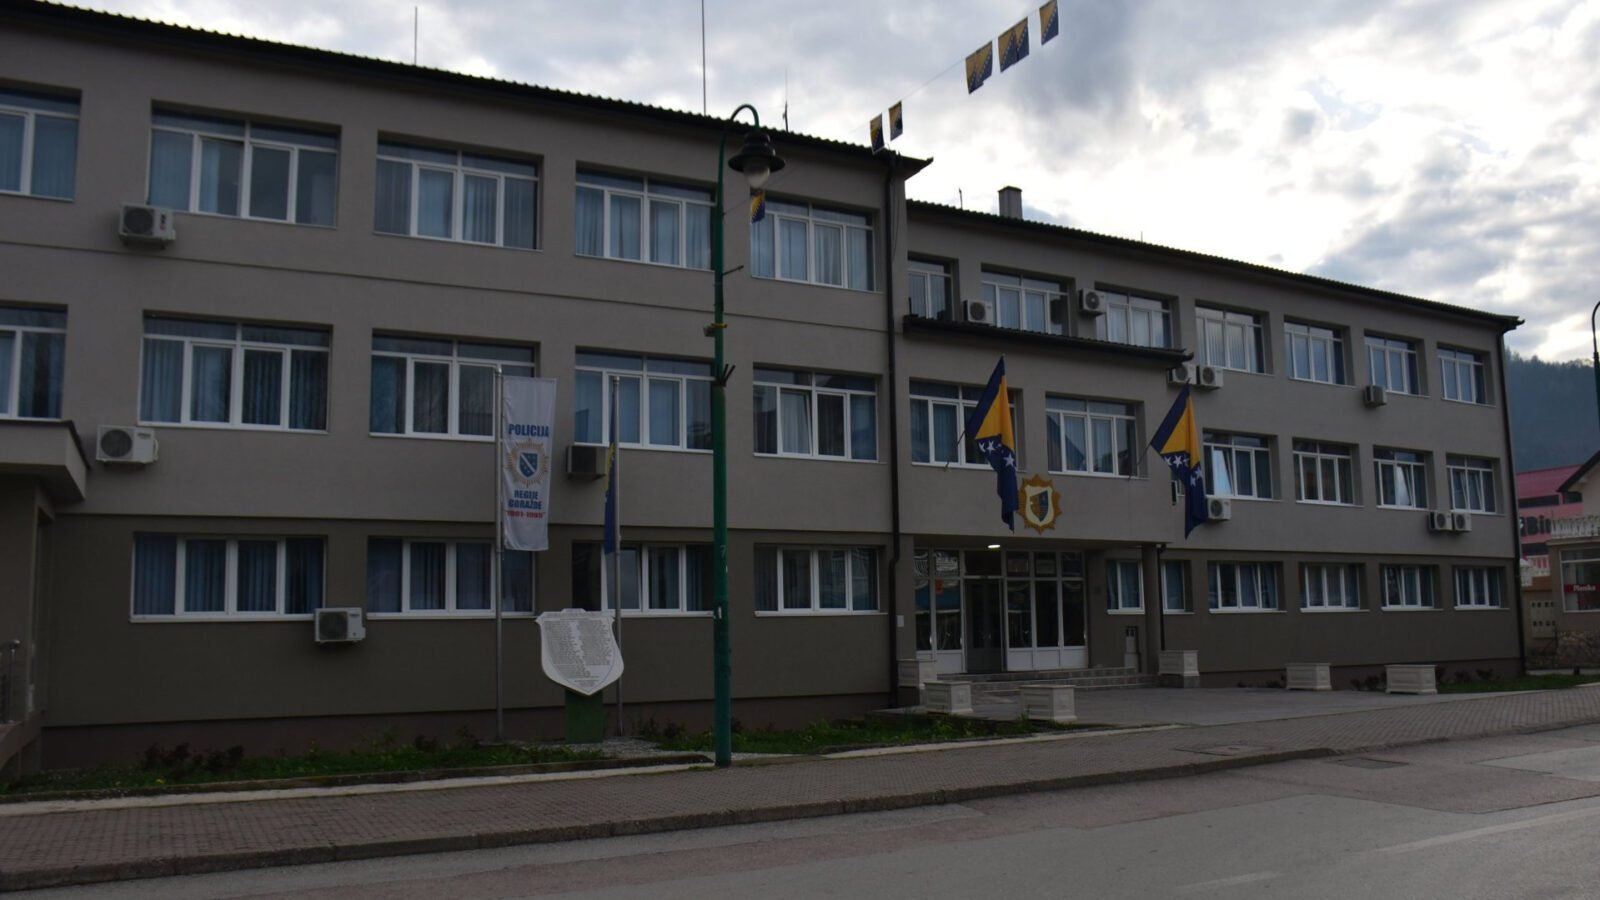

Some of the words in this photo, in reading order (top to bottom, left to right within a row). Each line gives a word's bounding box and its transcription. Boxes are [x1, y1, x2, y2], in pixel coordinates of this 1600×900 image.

[509, 424, 549, 437] POLICIJA
[515, 490, 538, 499] REGIJE
[509, 499, 542, 510] GORAŽDE
